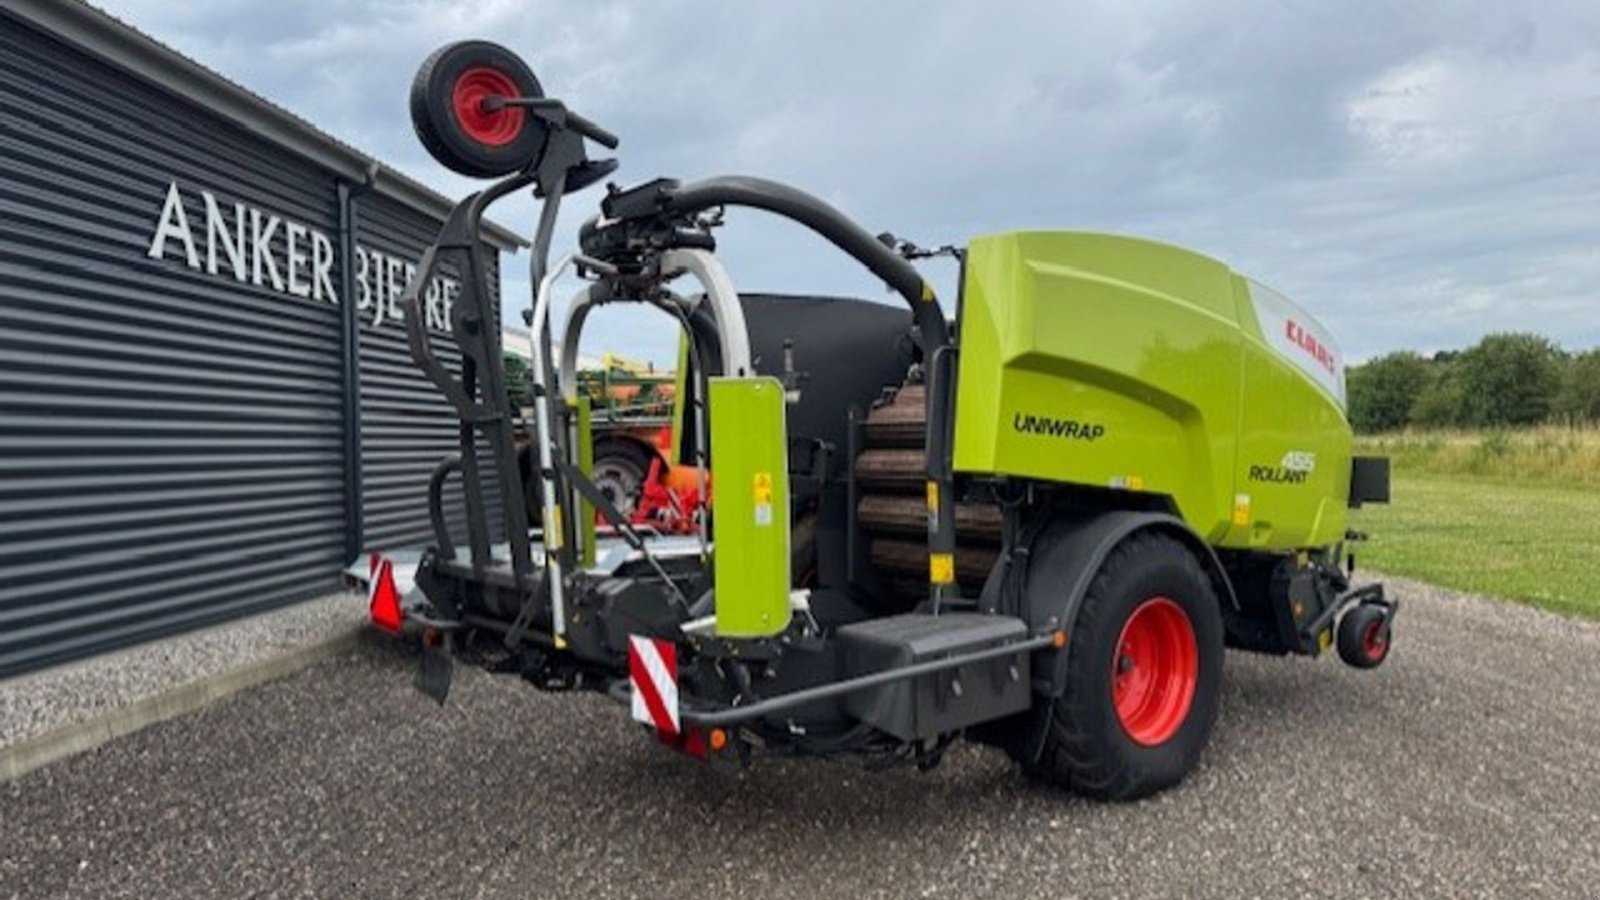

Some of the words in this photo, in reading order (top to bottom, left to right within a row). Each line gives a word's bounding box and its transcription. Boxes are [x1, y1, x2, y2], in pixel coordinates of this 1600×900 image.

[148, 180, 339, 304] ANKER
[1013, 412, 1105, 441] UNIWRAP
[1248, 465, 1308, 484] ROLLANT
